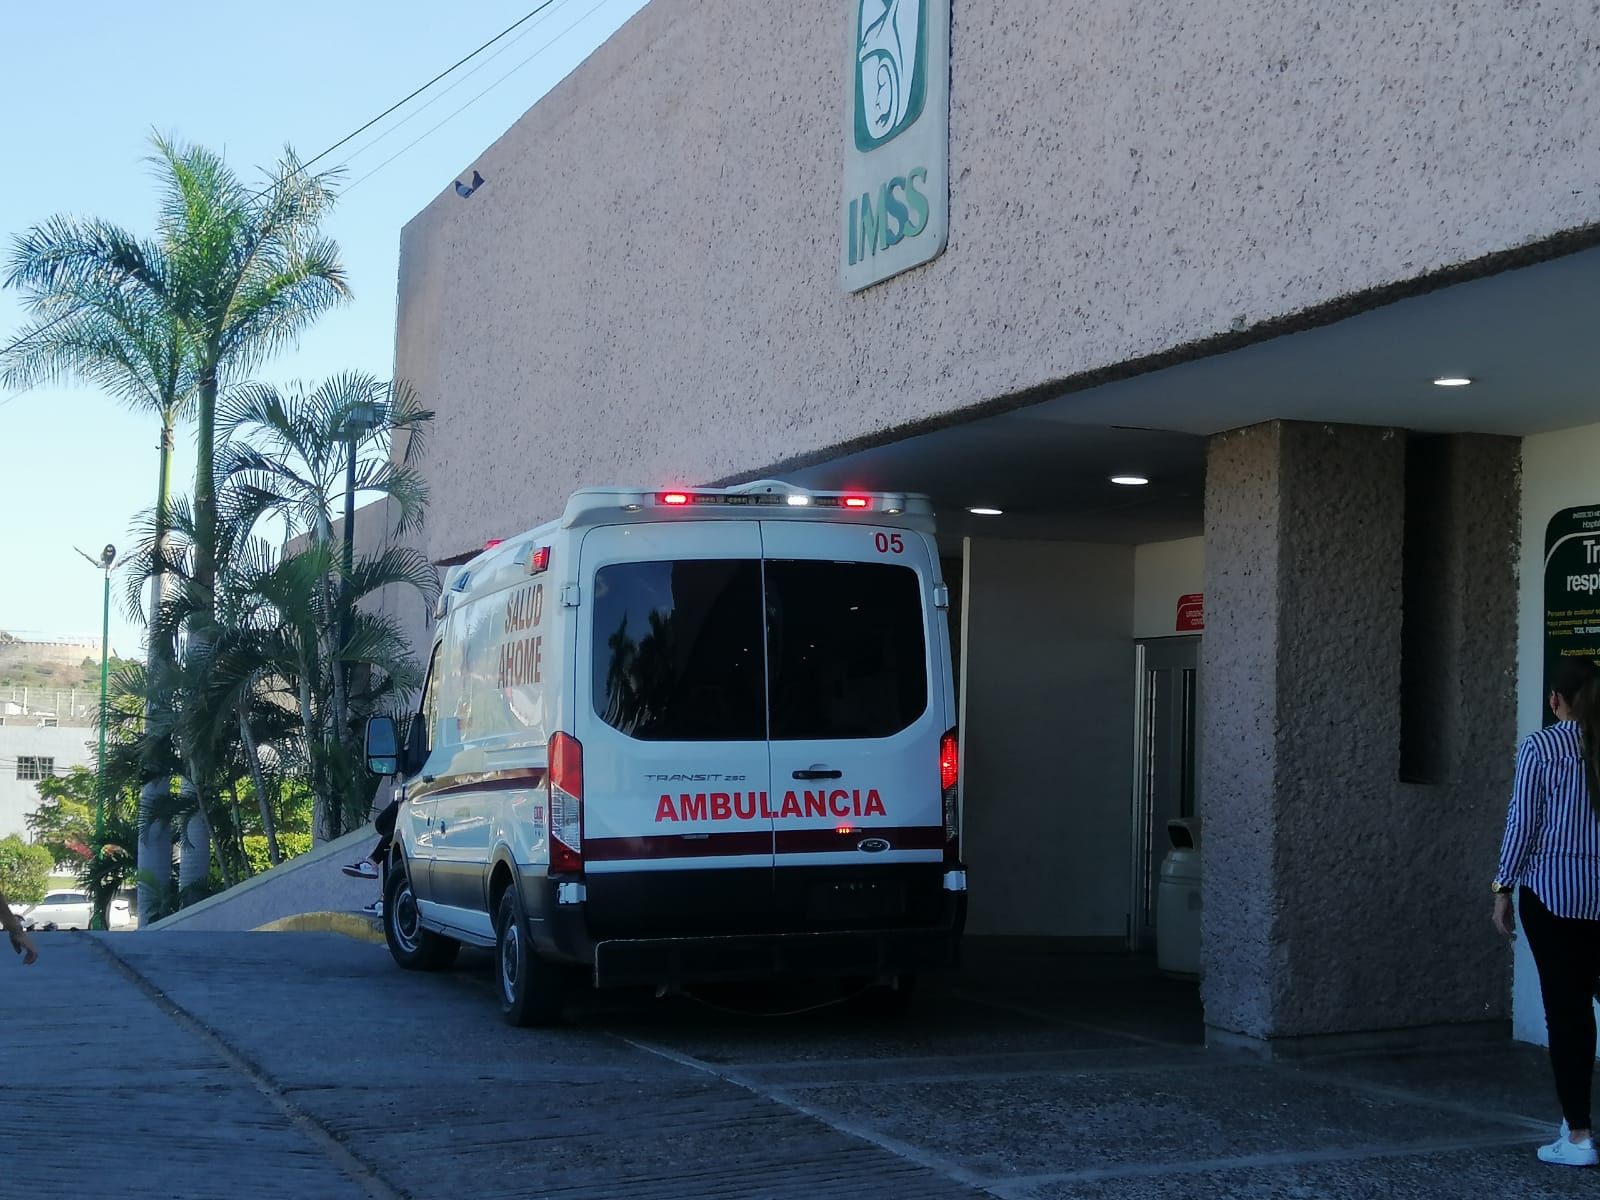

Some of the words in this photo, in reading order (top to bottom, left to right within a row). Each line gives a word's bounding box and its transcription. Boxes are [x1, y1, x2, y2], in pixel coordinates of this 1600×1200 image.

[848, 166, 929, 266] IMSS
[875, 532, 904, 554] 05
[1567, 569, 1600, 595] resp
[504, 584, 544, 634] SALUD
[498, 636, 542, 689] AHOME
[644, 773, 723, 782] TRANSIT
[655, 789, 887, 823] AMBULANCIA
